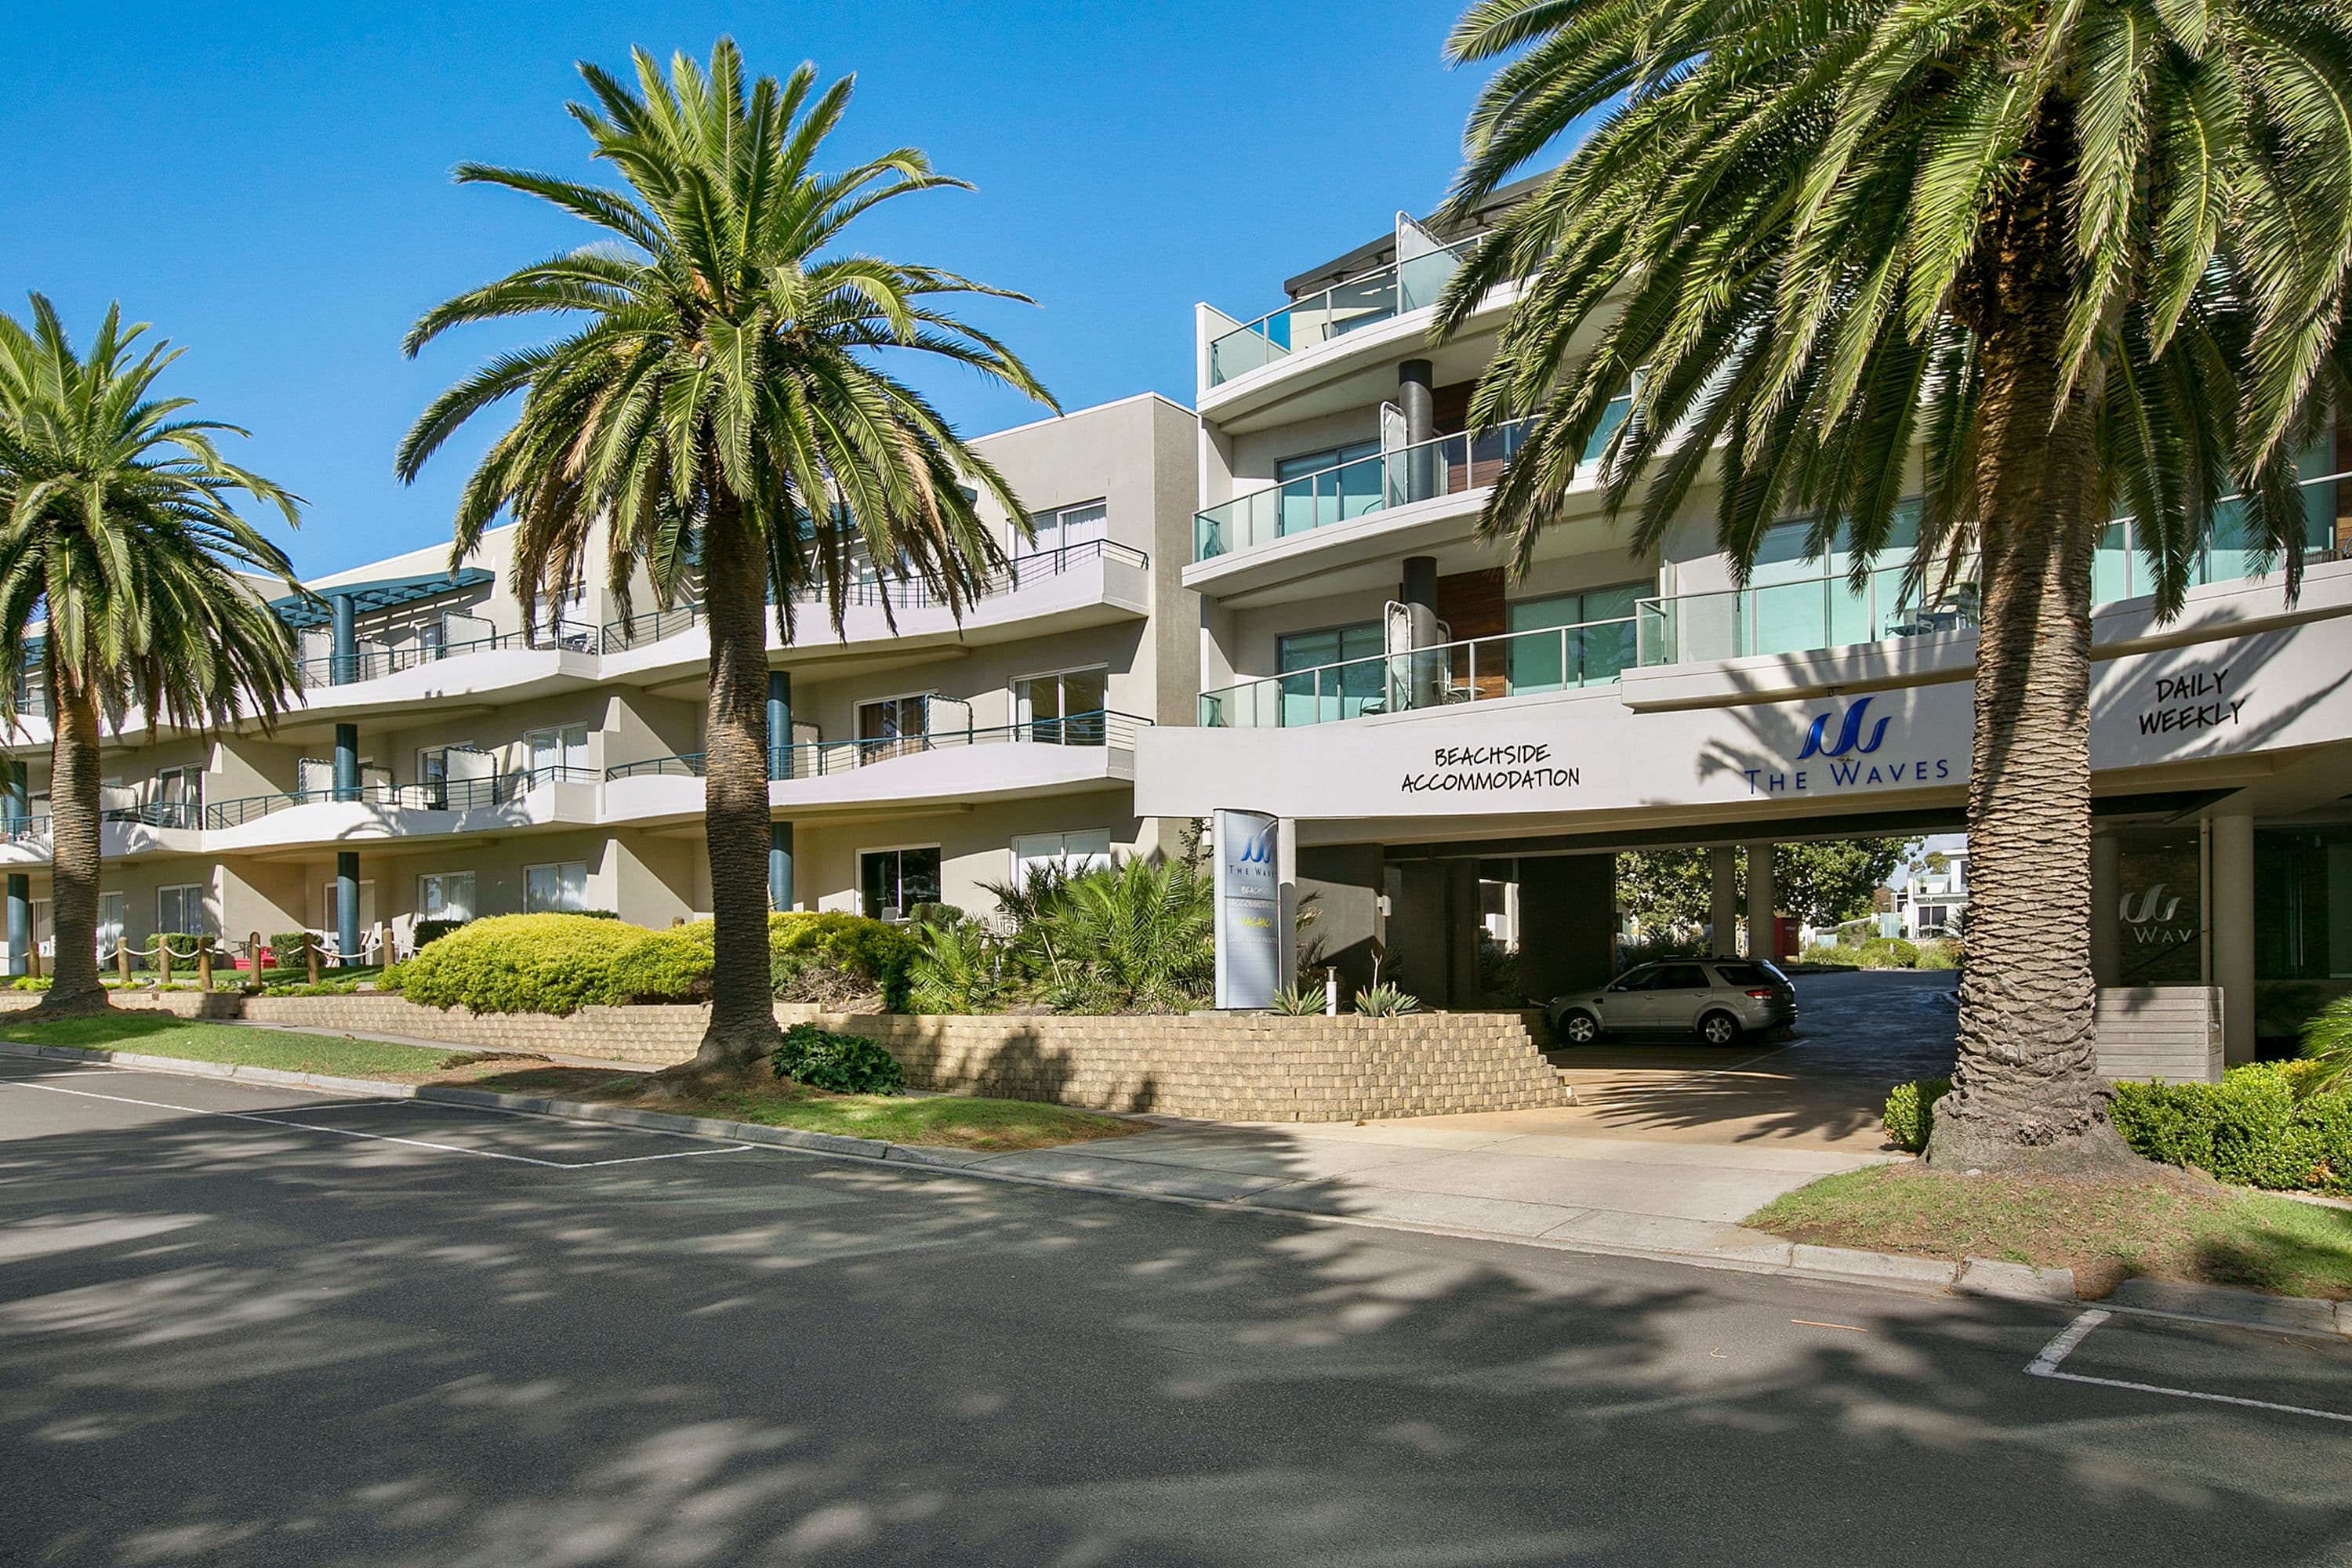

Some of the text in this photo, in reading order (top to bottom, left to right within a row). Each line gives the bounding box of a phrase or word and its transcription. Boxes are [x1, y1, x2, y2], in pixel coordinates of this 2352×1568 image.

[2155, 668, 2229, 703] DAILY
[2139, 699, 2246, 735] WEEKLY
[1435, 743, 1552, 768] BEACHSIDE
[1401, 768, 1580, 793] ACCOMMODATION
[1744, 759, 1949, 794] THE WAVES
[1229, 865, 1249, 876] THE
[2133, 926, 2192, 944] WAV
